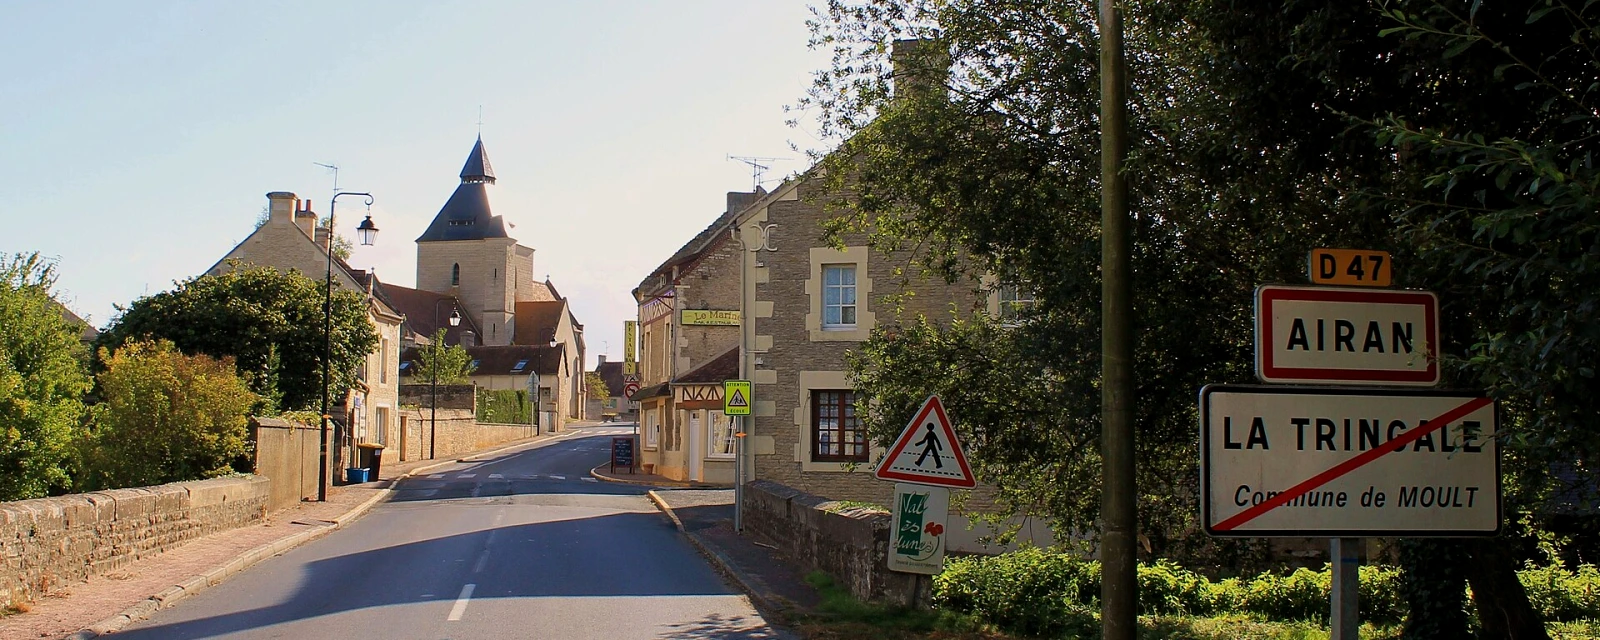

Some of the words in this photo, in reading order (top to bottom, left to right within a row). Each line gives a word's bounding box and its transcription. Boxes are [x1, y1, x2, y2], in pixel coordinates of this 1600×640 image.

[1319, 253, 1336, 279] D
[1346, 255, 1384, 281] 47
[1286, 318, 1413, 354] AIRAN
[1223, 416, 1270, 450] LA
[1290, 417, 1483, 454] TRINGALE
[902, 490, 931, 515] Val
[1360, 486, 1386, 508] de
[1398, 486, 1479, 508] MOULT
[892, 535, 934, 553] dunes
